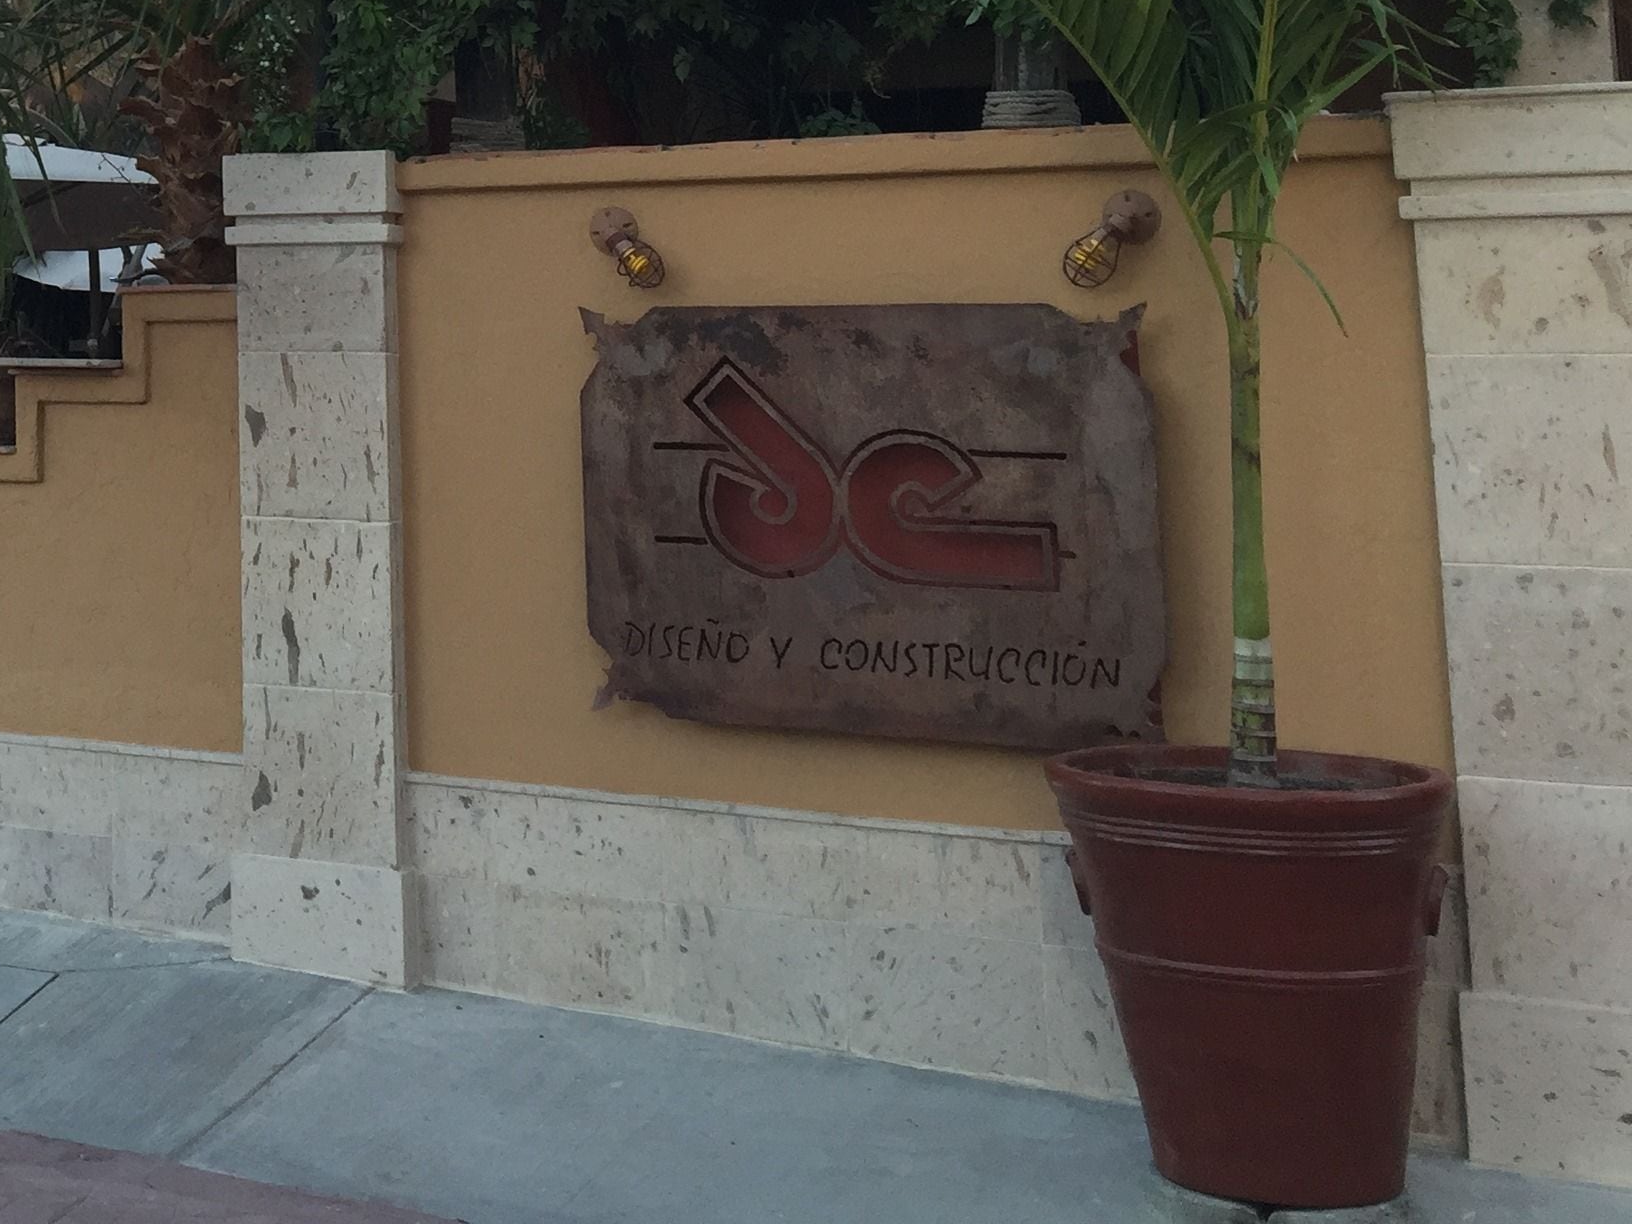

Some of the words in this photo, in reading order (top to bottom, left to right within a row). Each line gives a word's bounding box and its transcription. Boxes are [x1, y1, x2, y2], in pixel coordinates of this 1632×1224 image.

[623, 618, 750, 664] DISEÑO
[769, 636, 794, 670] Y
[820, 637, 1121, 690] CONSTRUCCIÓN
